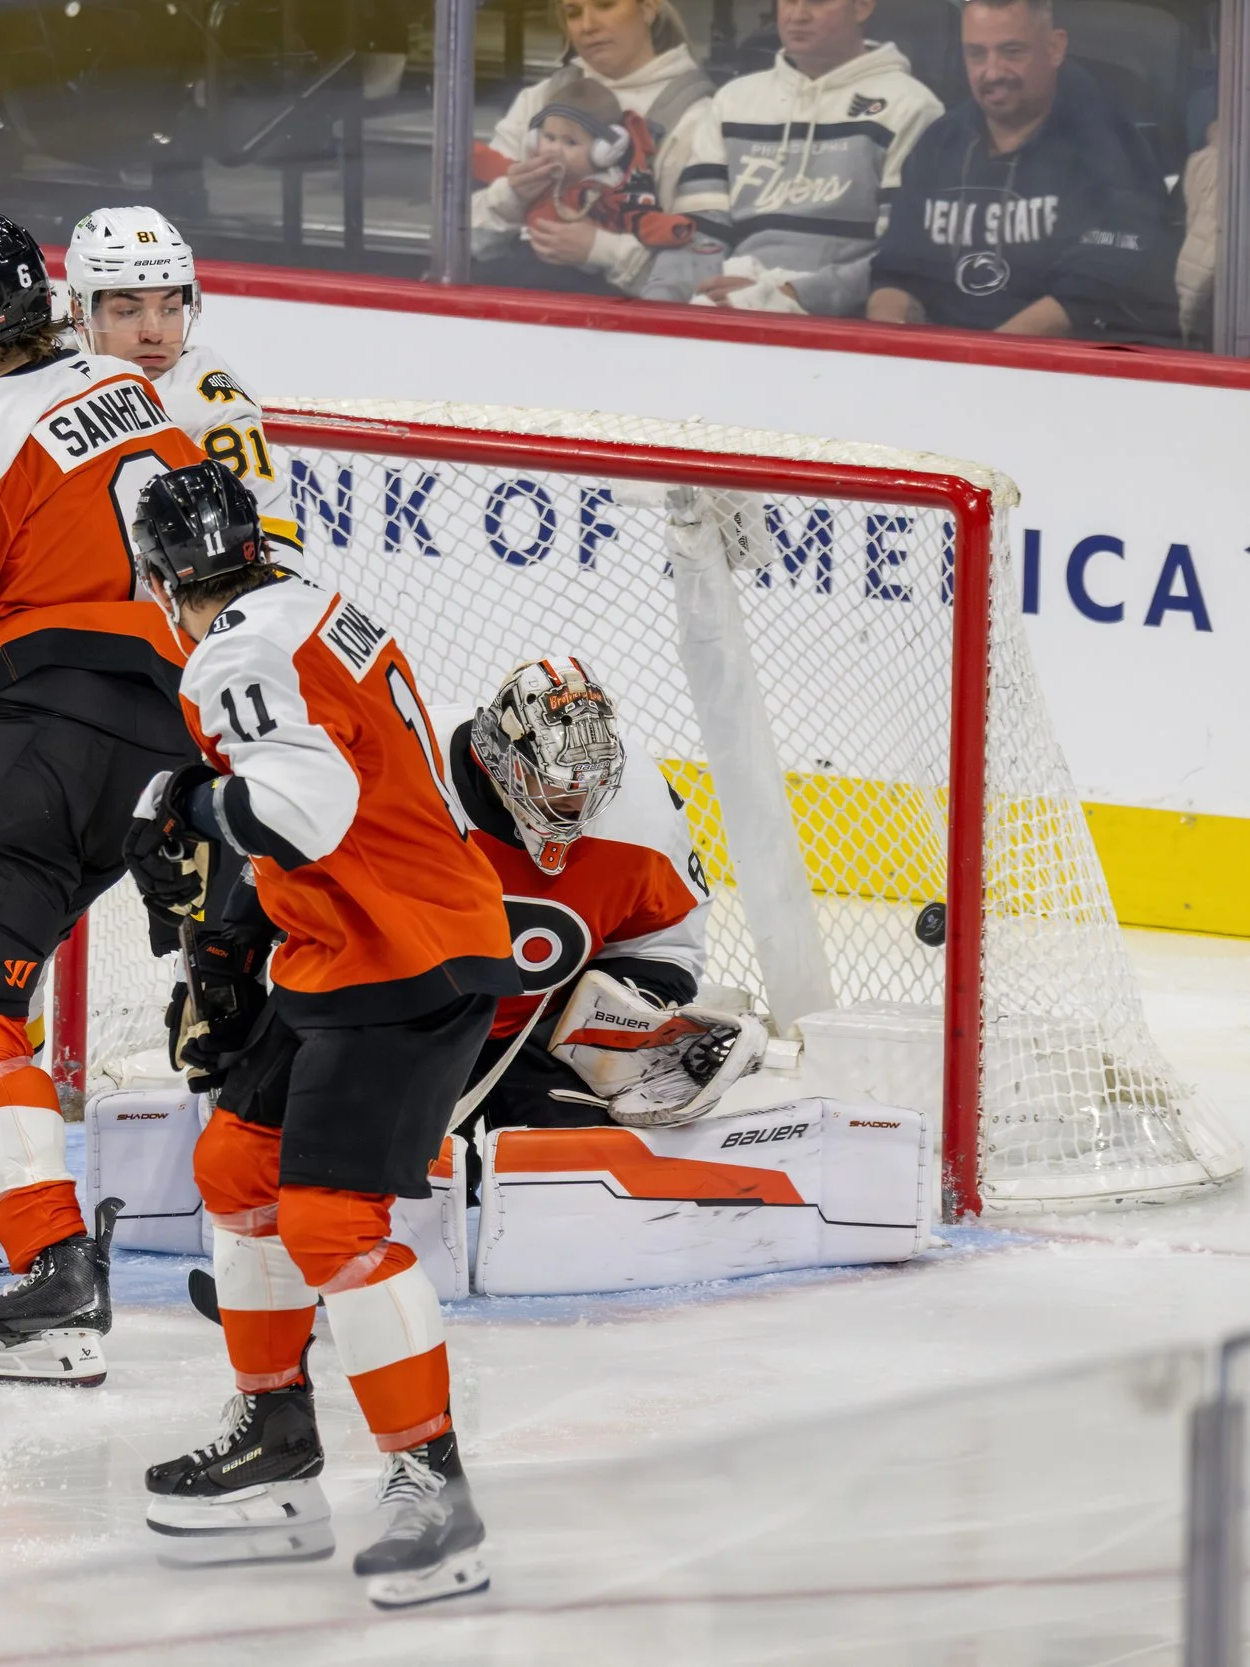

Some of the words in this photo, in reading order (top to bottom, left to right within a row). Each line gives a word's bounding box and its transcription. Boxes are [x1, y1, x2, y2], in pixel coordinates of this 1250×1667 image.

[137, 231, 158, 243] 81
[17, 264, 32, 288] 6
[201, 424, 274, 482] 81
[203, 530, 226, 558] 11
[291, 460, 441, 558] NK
[484, 479, 622, 571] OF
[663, 504, 1213, 634] MEICA
[220, 683, 278, 742] 11
[594, 1010, 650, 1030] BAUER
[117, 1112, 170, 1121] SHADOW
[849, 1120, 902, 1129] SHADOW
[720, 1123, 810, 1149] BAUER
[222, 1446, 263, 1474] BAUER
